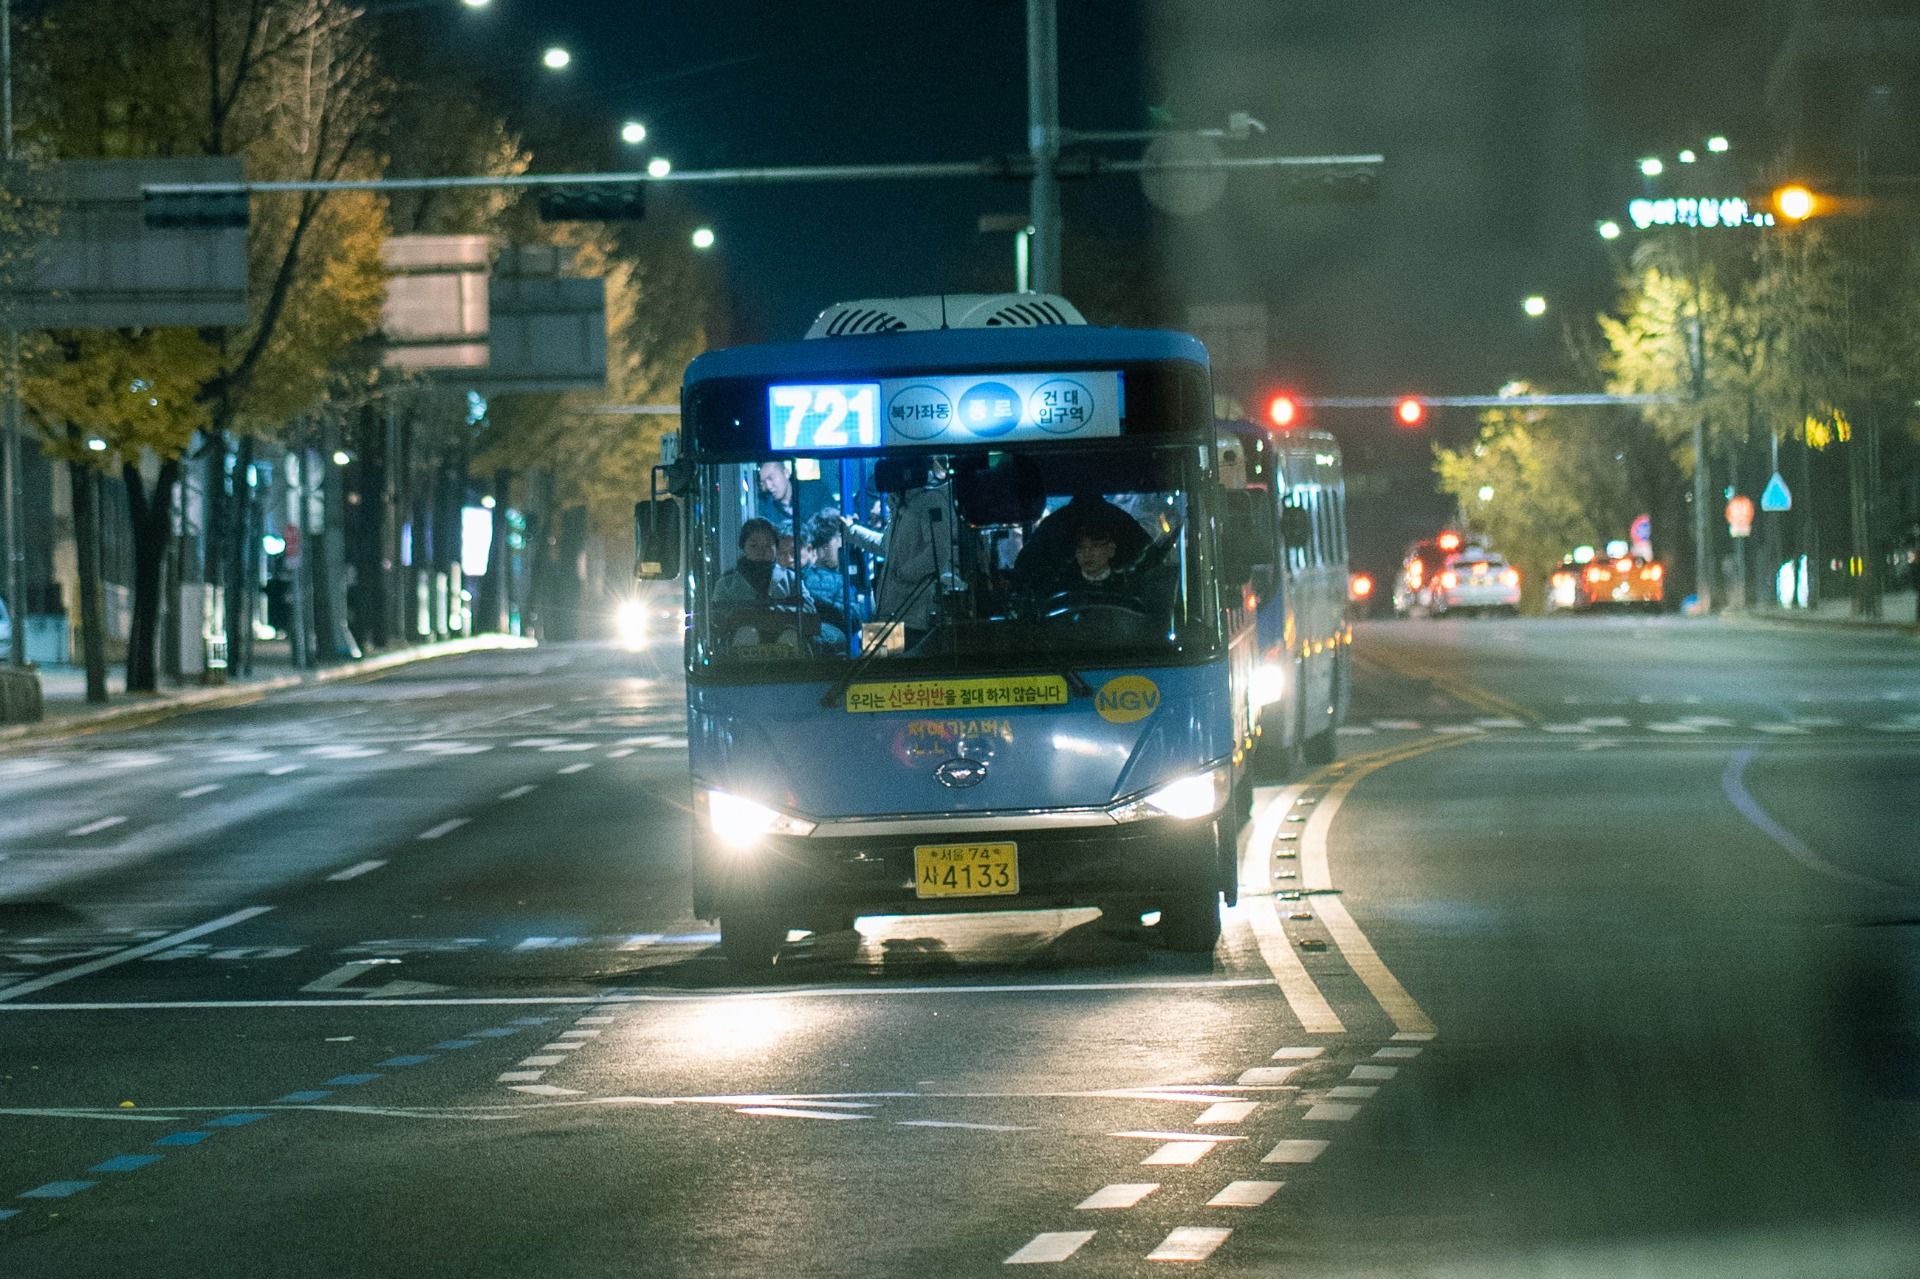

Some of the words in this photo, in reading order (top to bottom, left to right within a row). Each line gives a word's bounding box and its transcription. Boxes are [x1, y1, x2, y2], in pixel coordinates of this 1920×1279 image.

[775, 388, 873, 447] 721
[891, 403, 950, 420] 북가좌동
[1039, 406, 1084, 424] 입구역
[850, 692, 886, 709] 우리는
[888, 686, 957, 708] 신호위반을
[1013, 684, 1061, 702] 않습니다
[1100, 689, 1157, 711] NGV
[940, 848, 964, 861] 서울
[968, 847, 991, 860] 74
[942, 863, 1009, 889] 4133
